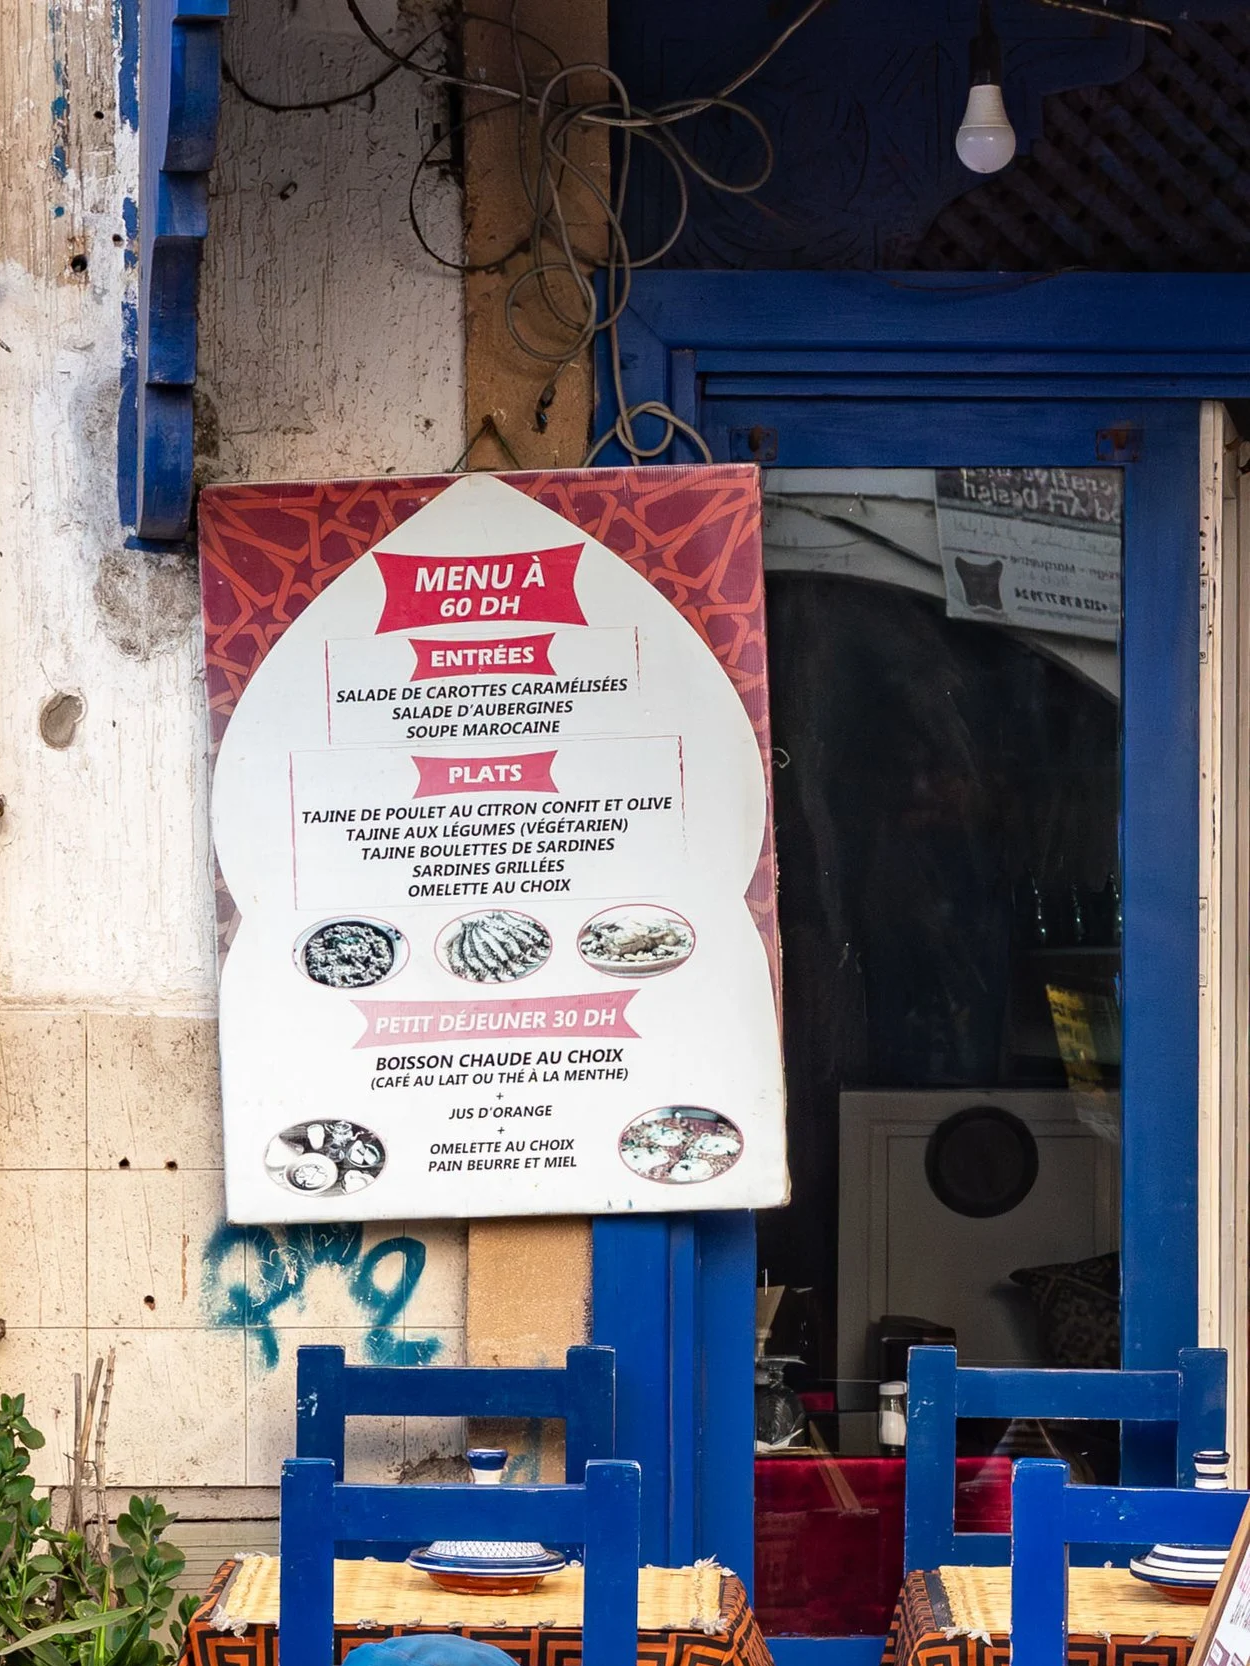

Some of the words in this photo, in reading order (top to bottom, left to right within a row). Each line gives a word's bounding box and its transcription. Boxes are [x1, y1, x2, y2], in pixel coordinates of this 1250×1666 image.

[415, 564, 513, 592] MENU
[521, 555, 545, 588] À
[440, 597, 472, 617] 60
[480, 596, 520, 615] DH
[431, 644, 534, 667] ENTRÉES
[336, 688, 397, 703] SALADE
[402, 687, 422, 700] DE
[426, 684, 507, 699] CAROTTES
[512, 676, 628, 695] CARAMÉLISÉES
[392, 705, 453, 720] SALADE
[457, 700, 573, 717] D'AUBERGINES
[406, 724, 458, 739] SOUPE
[463, 720, 560, 736] MAROCAINE
[449, 764, 522, 784] PLATS
[302, 809, 356, 824] TAJINE
[361, 808, 381, 821] DE
[386, 806, 446, 820] POULET
[449, 805, 472, 818] AU
[477, 802, 537, 817] CITRON
[542, 800, 600, 814] CONFIT
[604, 799, 623, 812] ET
[627, 797, 672, 810] OLIVE
[346, 827, 400, 841] TAJINE
[404, 826, 438, 839] AUX
[443, 821, 515, 837] LÉGUMES
[520, 817, 628, 837] (VÉGÉTARIEN)
[362, 846, 415, 860] TAJINE
[420, 842, 507, 858] BOULETTES
[512, 841, 532, 854] DE
[536, 838, 615, 853] SARDINES
[412, 862, 490, 877] SARDINES
[495, 857, 565, 874] GRILLÉES
[408, 882, 488, 897] OMELETTE
[492, 881, 515, 894] AU
[520, 879, 571, 893] CHOIX
[375, 1015, 434, 1034] PETIT
[438, 1009, 546, 1032] DÉJEUNER
[553, 1010, 577, 1028] 30
[583, 1008, 616, 1026] DH
[376, 1055, 453, 1071] BOISSON
[459, 1052, 532, 1067] CHAUDE
[536, 1051, 562, 1065] AU
[568, 1048, 623, 1063] CHOIX
[371, 1073, 410, 1090] (CAFÉ
[413, 1075, 434, 1087] AU
[439, 1074, 469, 1086] LAIT
[472, 1073, 493, 1084] OU
[498, 1070, 524, 1083] THÉ
[528, 1068, 538, 1082] À
[543, 1071, 559, 1082] LA
[564, 1068, 628, 1081] MENTHE)
[449, 1108, 474, 1120] JUS
[478, 1105, 552, 1118] D'ORANGE
[430, 1141, 501, 1155] OMELETTE
[505, 1141, 525, 1152] AU
[530, 1139, 574, 1151] CHOIX
[428, 1160, 462, 1172] PAIN
[467, 1158, 520, 1171] BEURRE
[524, 1157, 541, 1169] ET
[544, 1156, 577, 1168] MIEL
